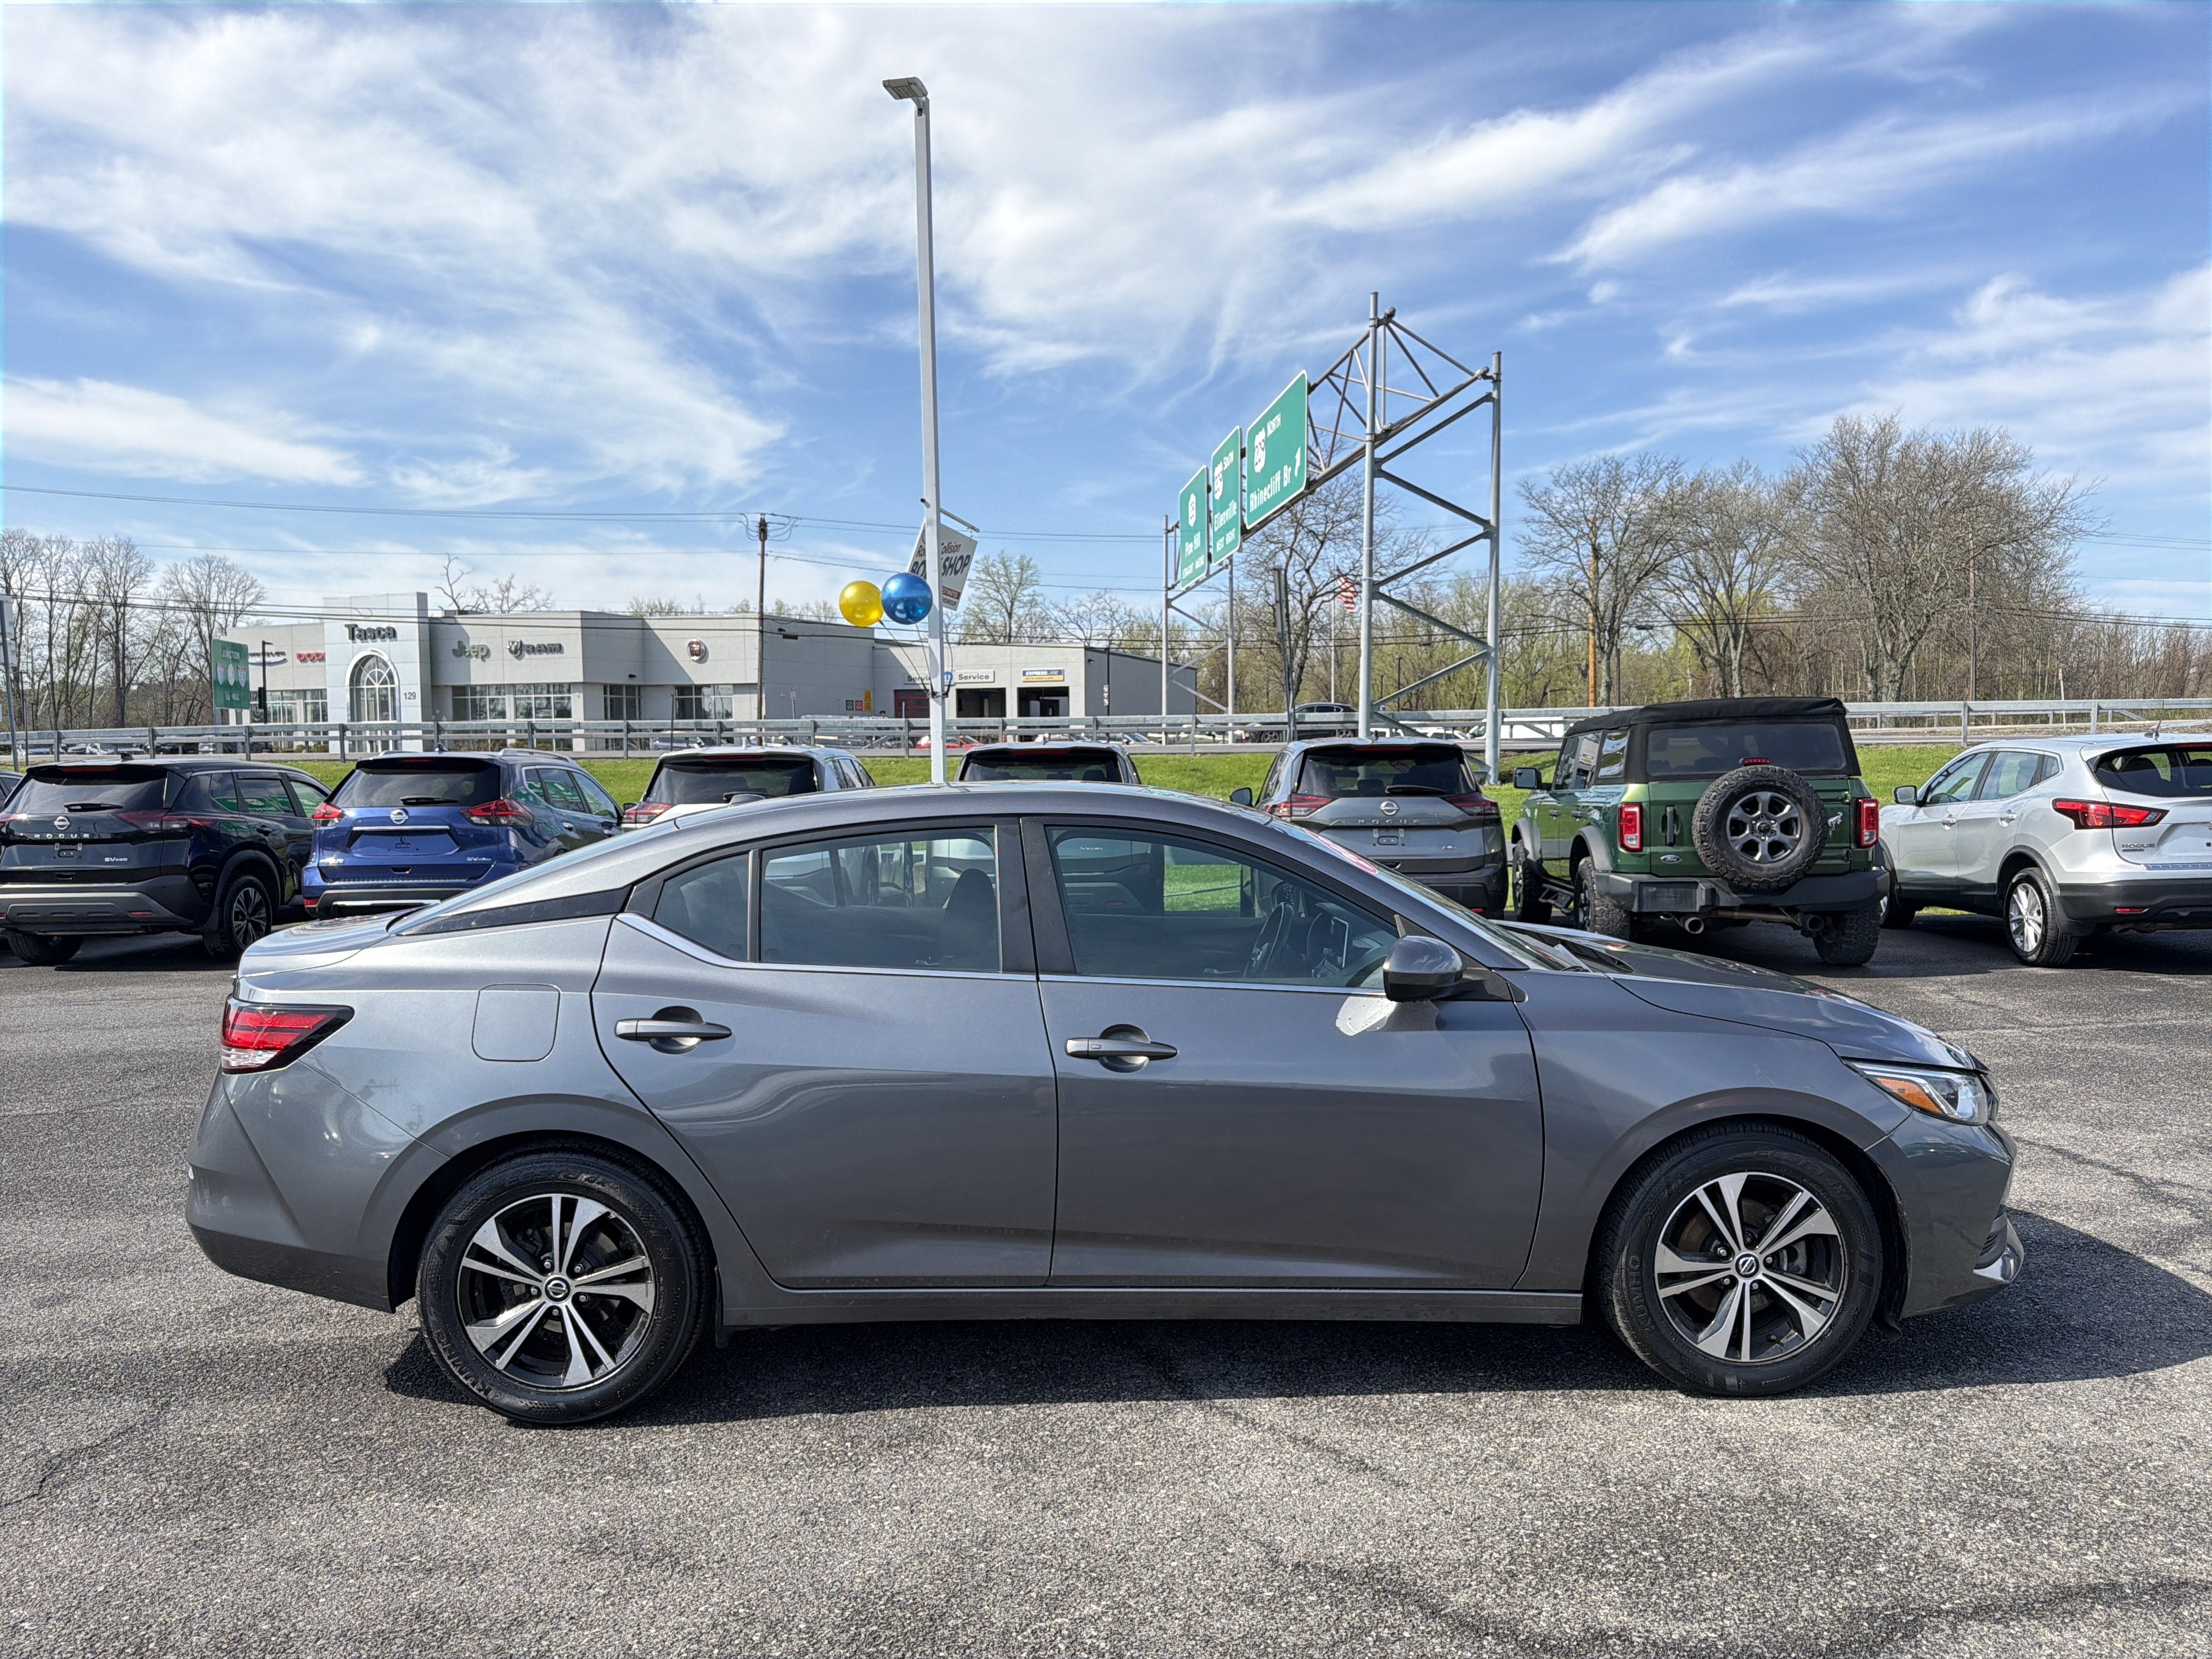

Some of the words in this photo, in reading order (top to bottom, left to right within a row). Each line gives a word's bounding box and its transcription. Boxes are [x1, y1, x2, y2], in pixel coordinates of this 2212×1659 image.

[1250, 470, 1281, 513] Rhinecliff
[1283, 465, 1292, 487] Br
[943, 554, 972, 578] SHOP
[345, 624, 398, 641] Tasca
[452, 641, 489, 661] Jeep
[524, 643, 563, 654] RAM
[958, 673, 990, 681] Service
[403, 691, 416, 701] 129
[1628, 1255, 1655, 1332] KUMHO
